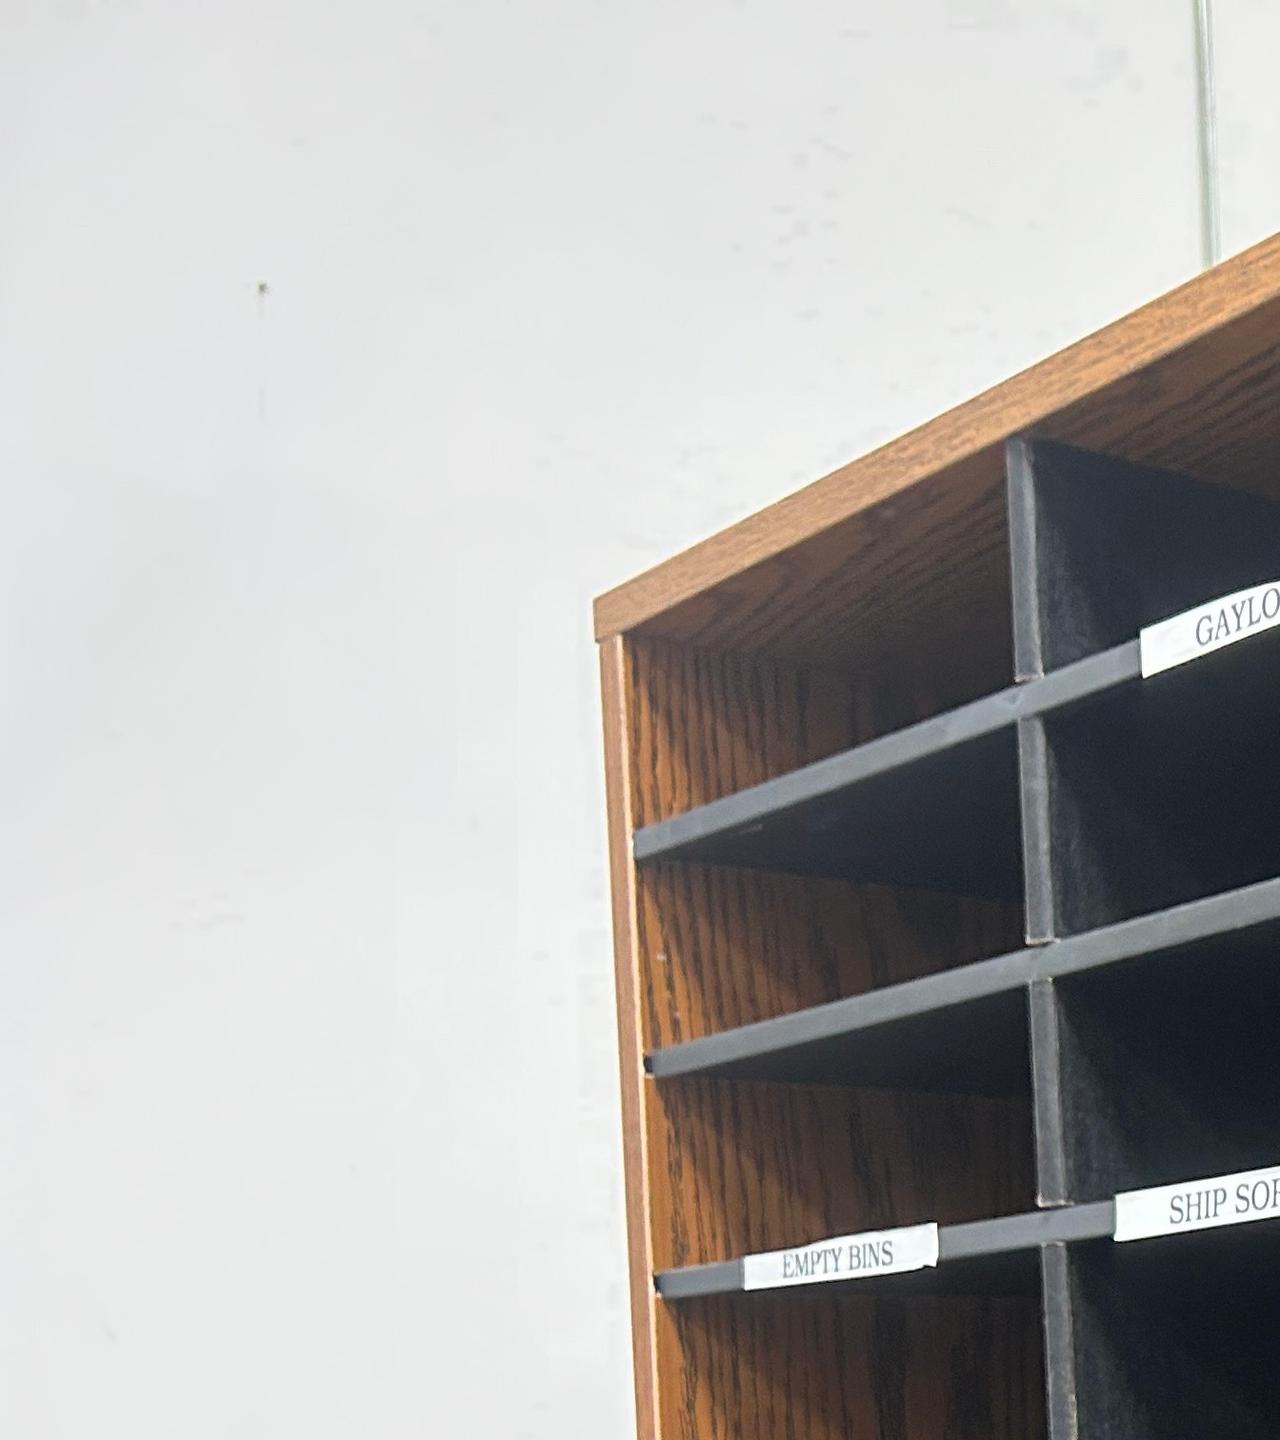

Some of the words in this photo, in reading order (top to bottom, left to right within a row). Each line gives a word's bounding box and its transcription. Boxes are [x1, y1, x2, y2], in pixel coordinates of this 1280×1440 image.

[1169, 1187, 1229, 1225] SHIP
[782, 1247, 843, 1279] EMPTY
[849, 1240, 894, 1271] BINS
